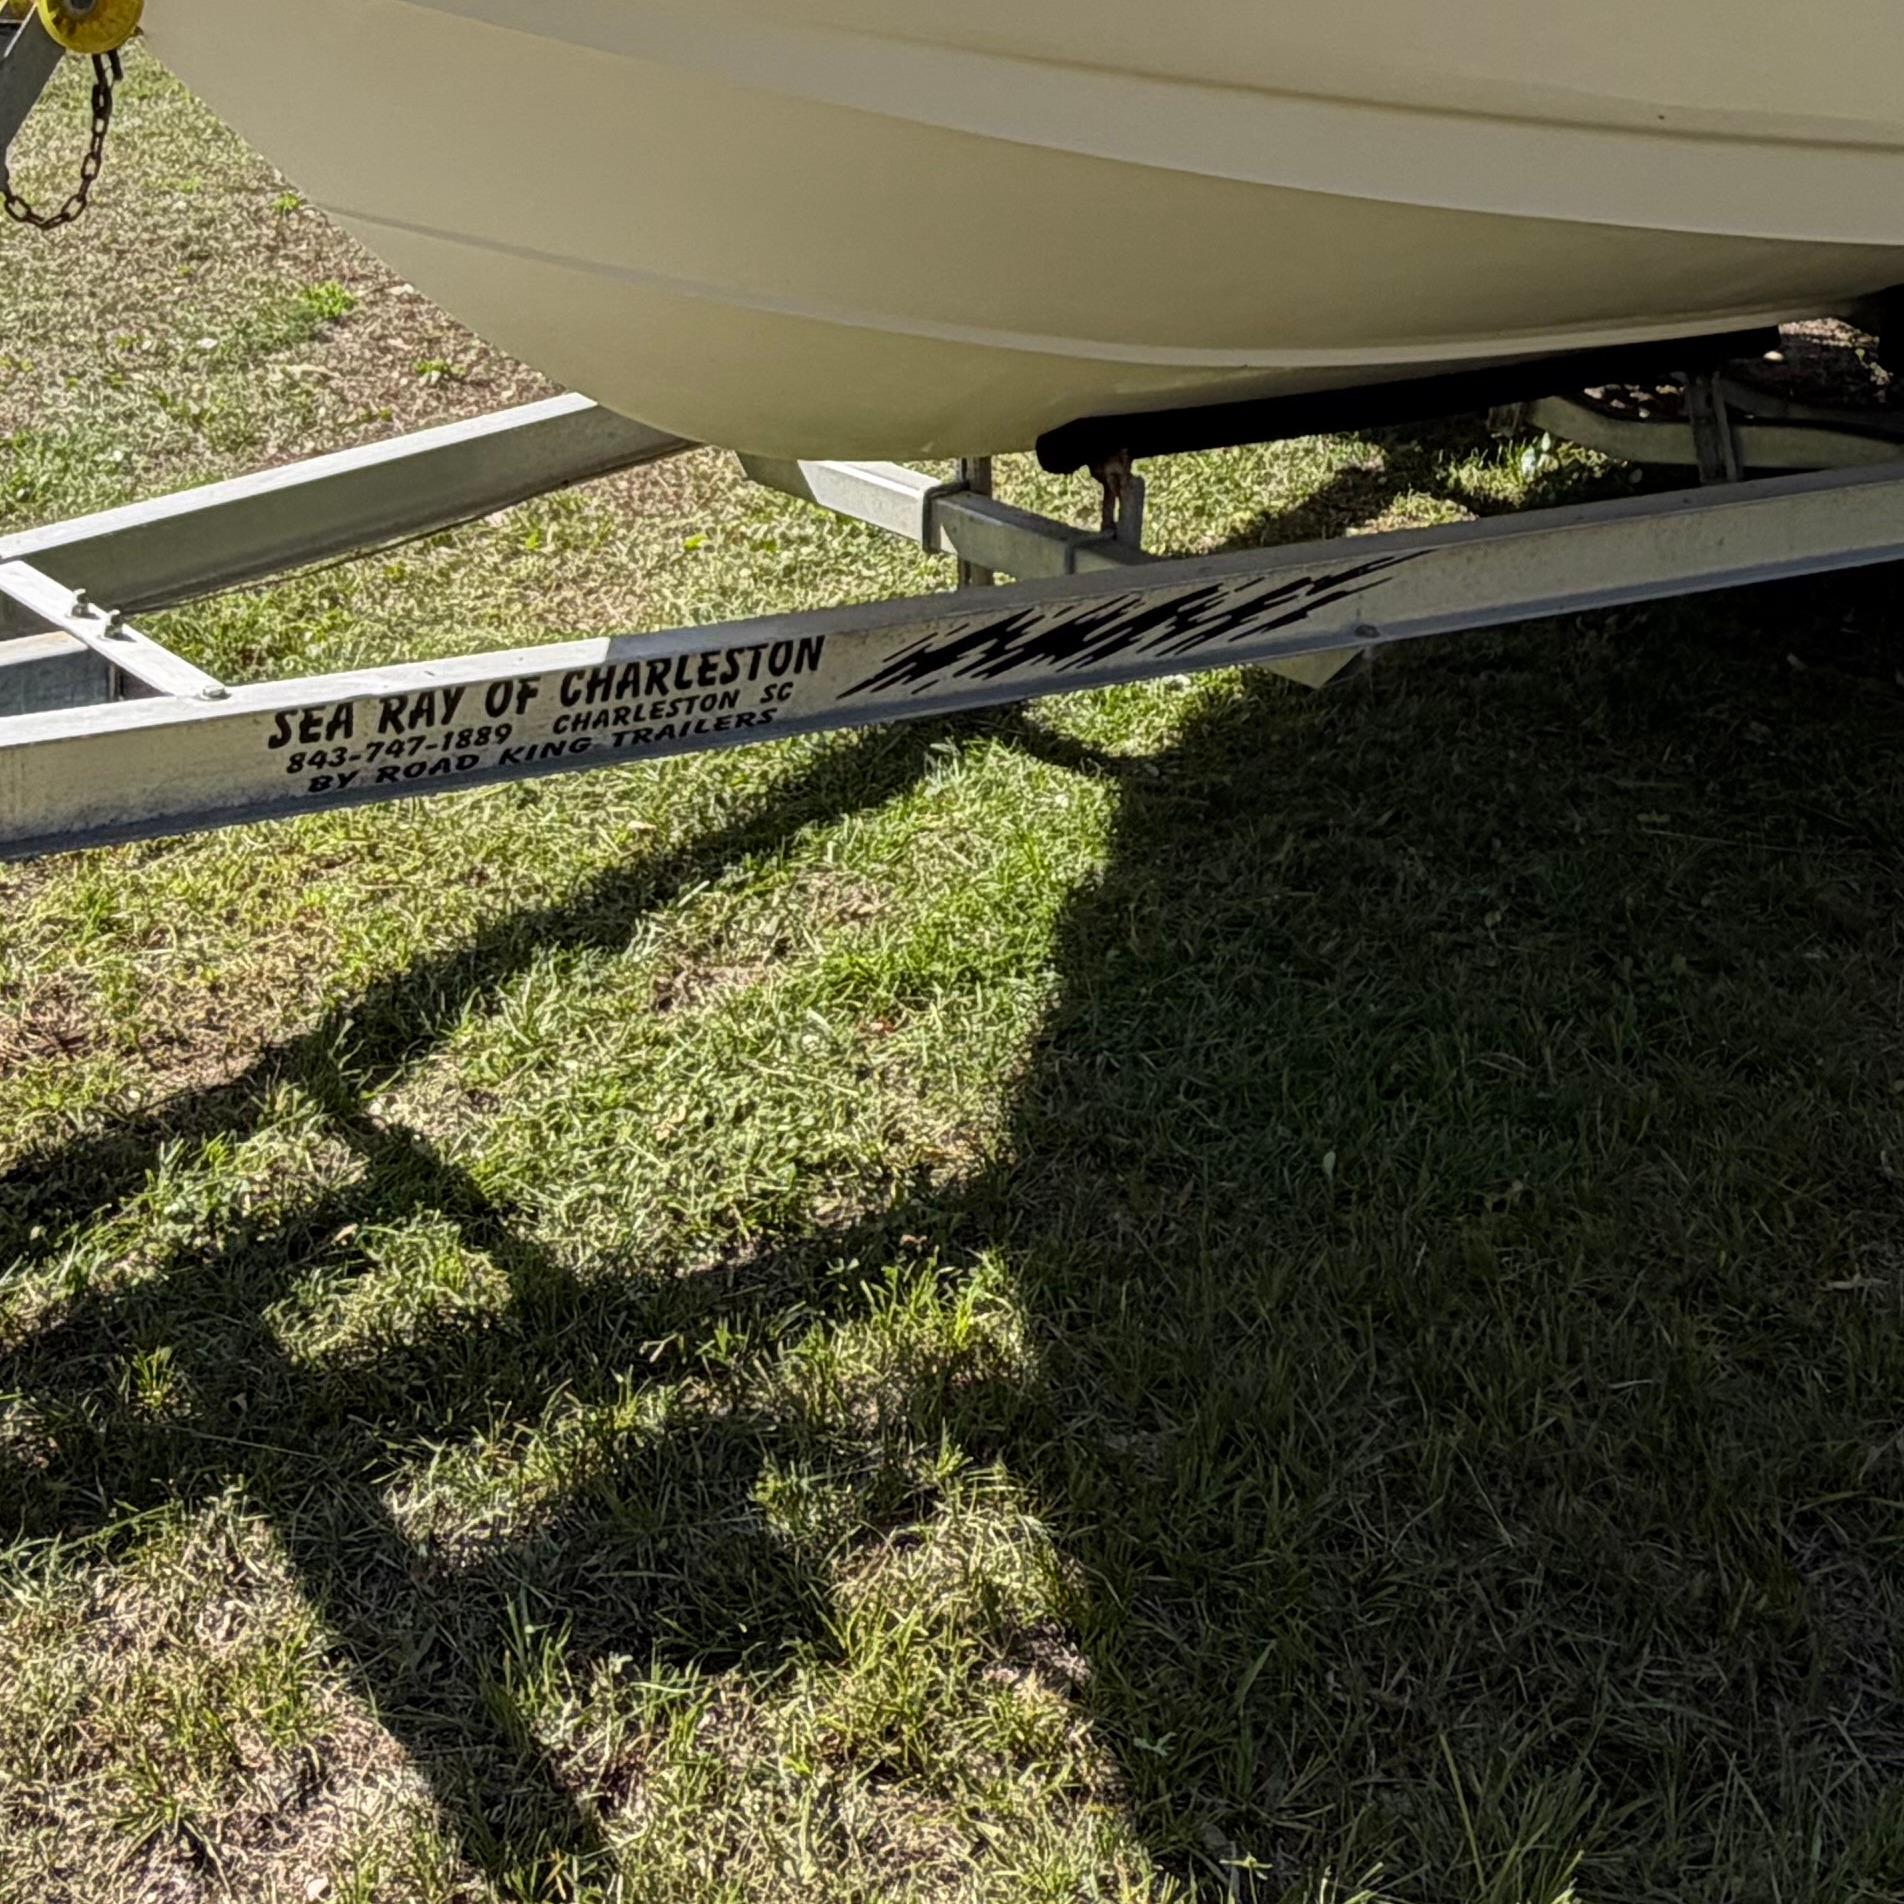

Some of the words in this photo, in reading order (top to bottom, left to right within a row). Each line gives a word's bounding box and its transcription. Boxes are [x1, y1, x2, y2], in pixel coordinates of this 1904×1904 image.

[268, 701, 354, 750] SEA
[377, 686, 466, 735] RAY
[485, 675, 542, 718] OF
[559, 635, 826, 708] CHARLESTON
[286, 723, 513, 774] 843-747-1889
[552, 689, 741, 736] CHARLESTON
[760, 682, 795, 704] SC
[308, 769, 360, 793] BY
[375, 754, 481, 784] ROAD
[498, 736, 592, 766] KING
[611, 707, 779, 748] TRAILERS
